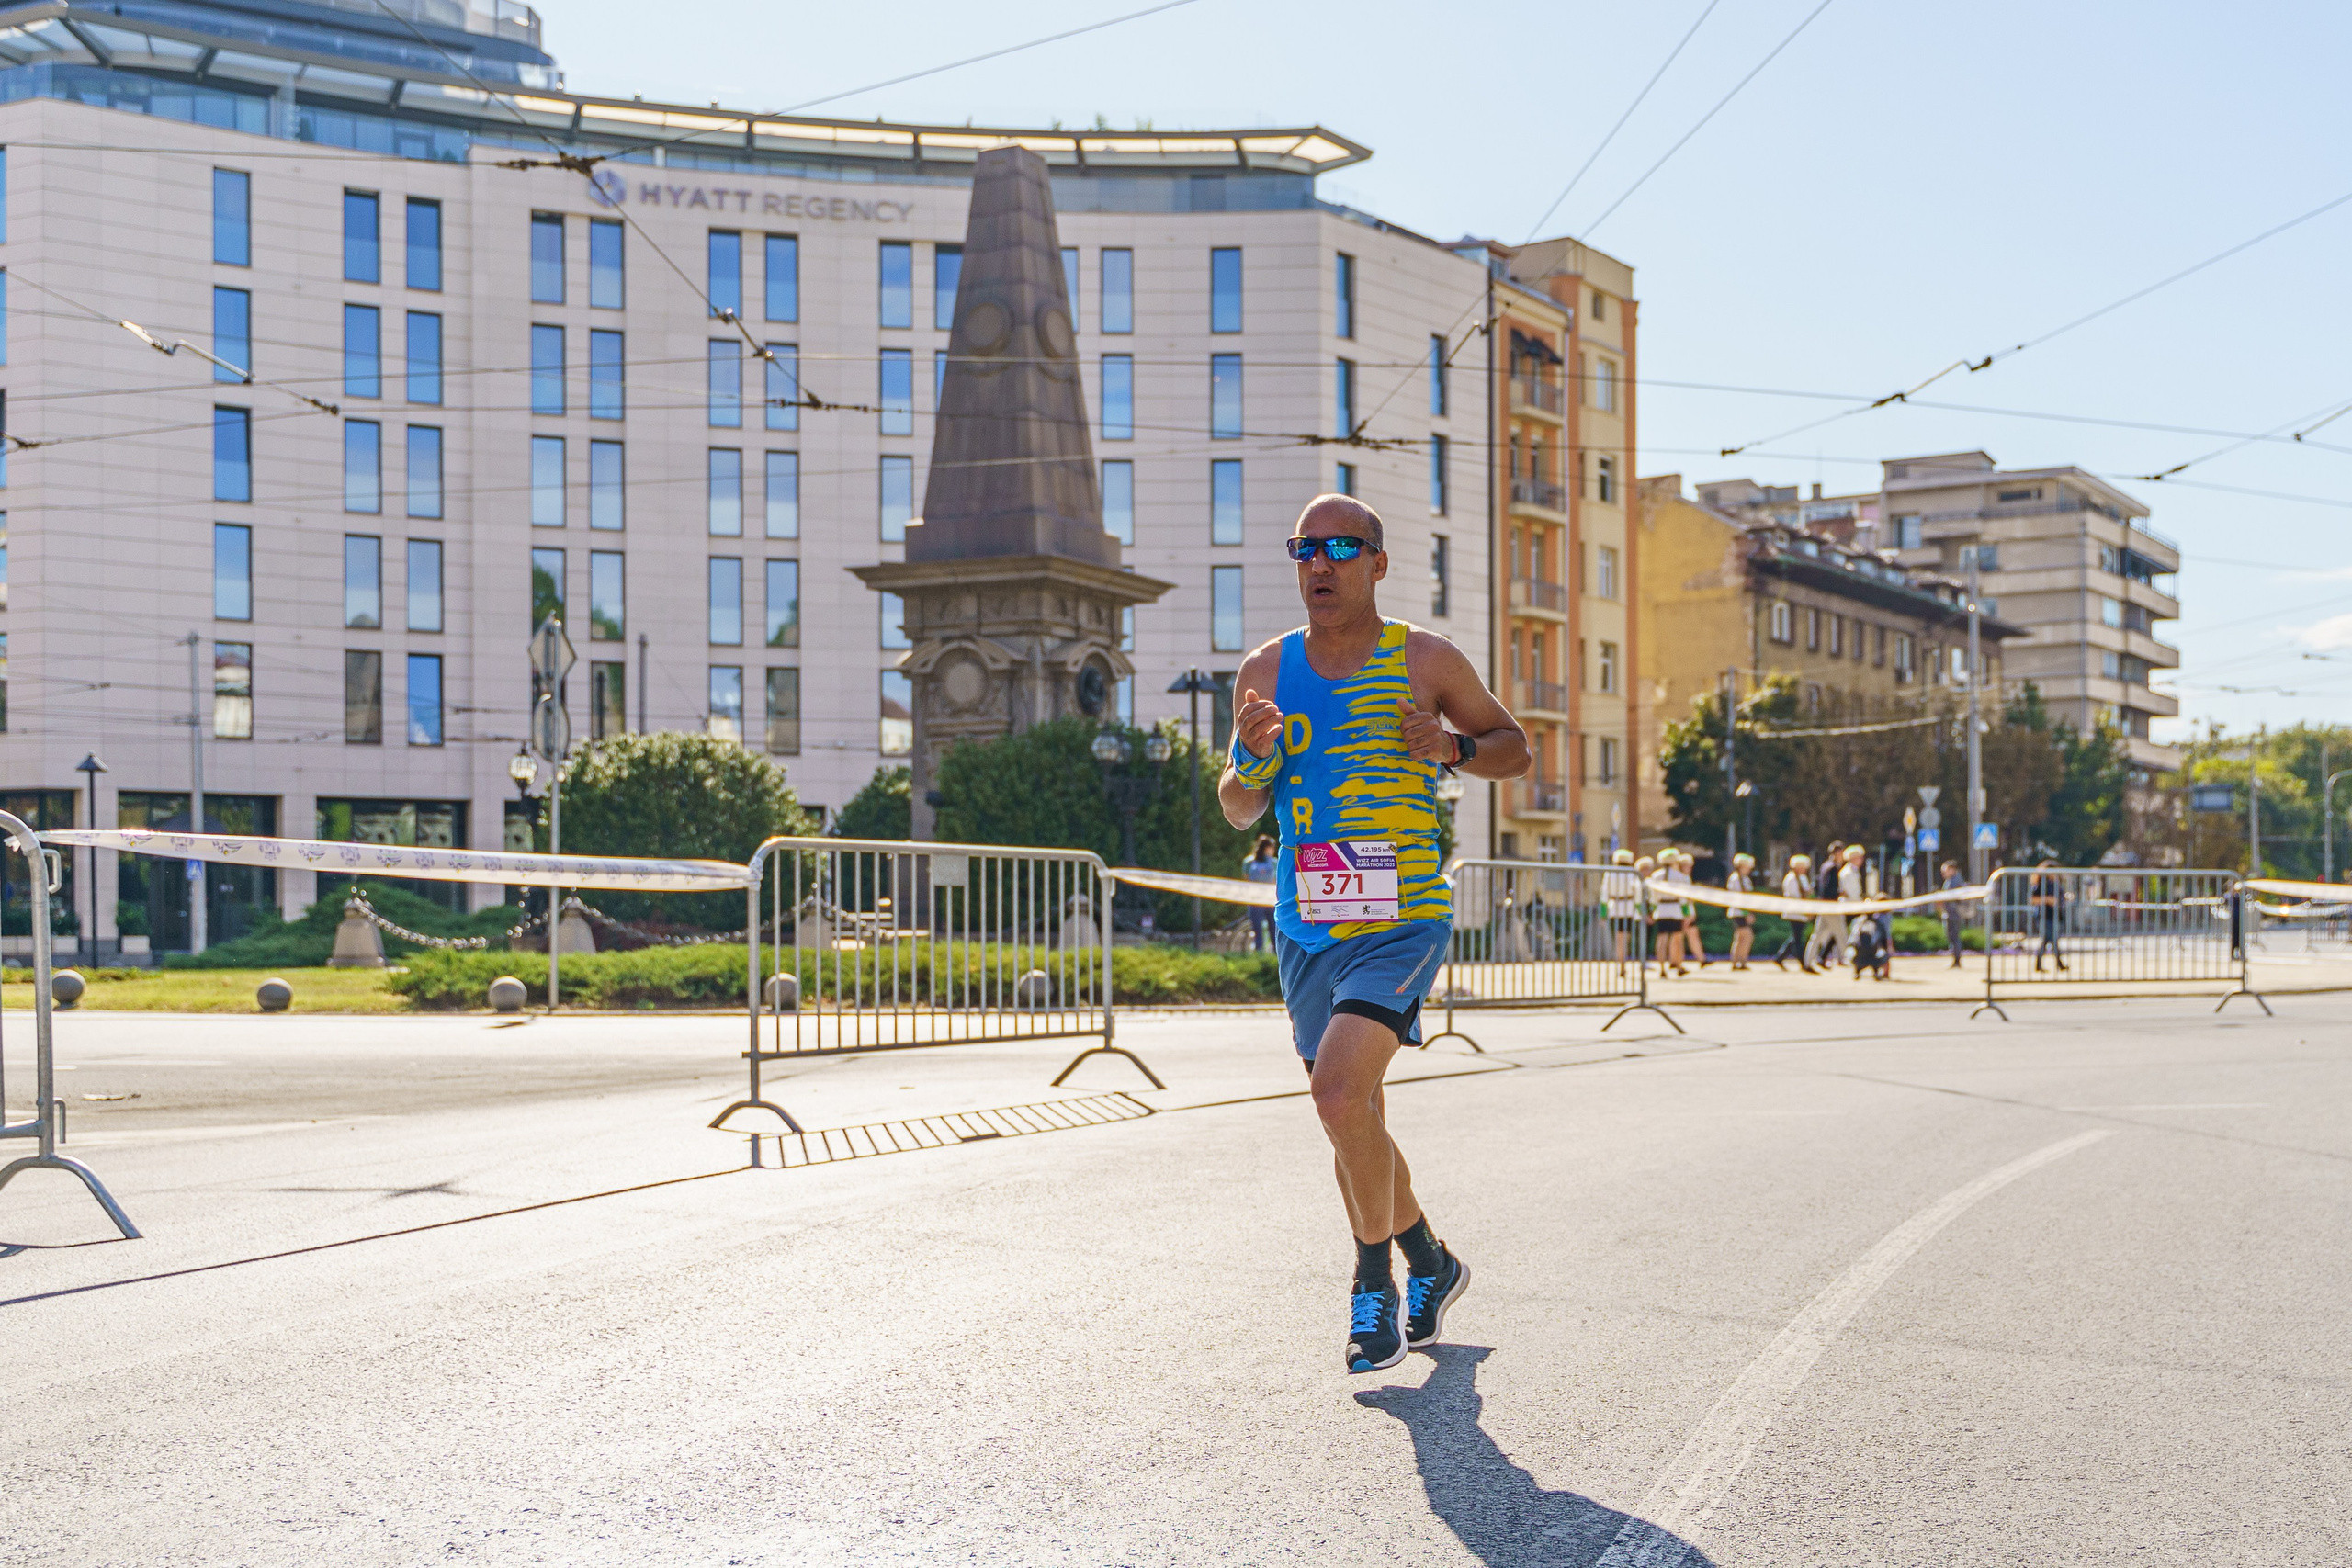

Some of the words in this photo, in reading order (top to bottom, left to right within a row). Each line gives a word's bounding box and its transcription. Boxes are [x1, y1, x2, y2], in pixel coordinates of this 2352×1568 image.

[640, 183, 752, 212] HYATT
[762, 193, 914, 223] REGENCY
[1321, 873, 1363, 895] 371
